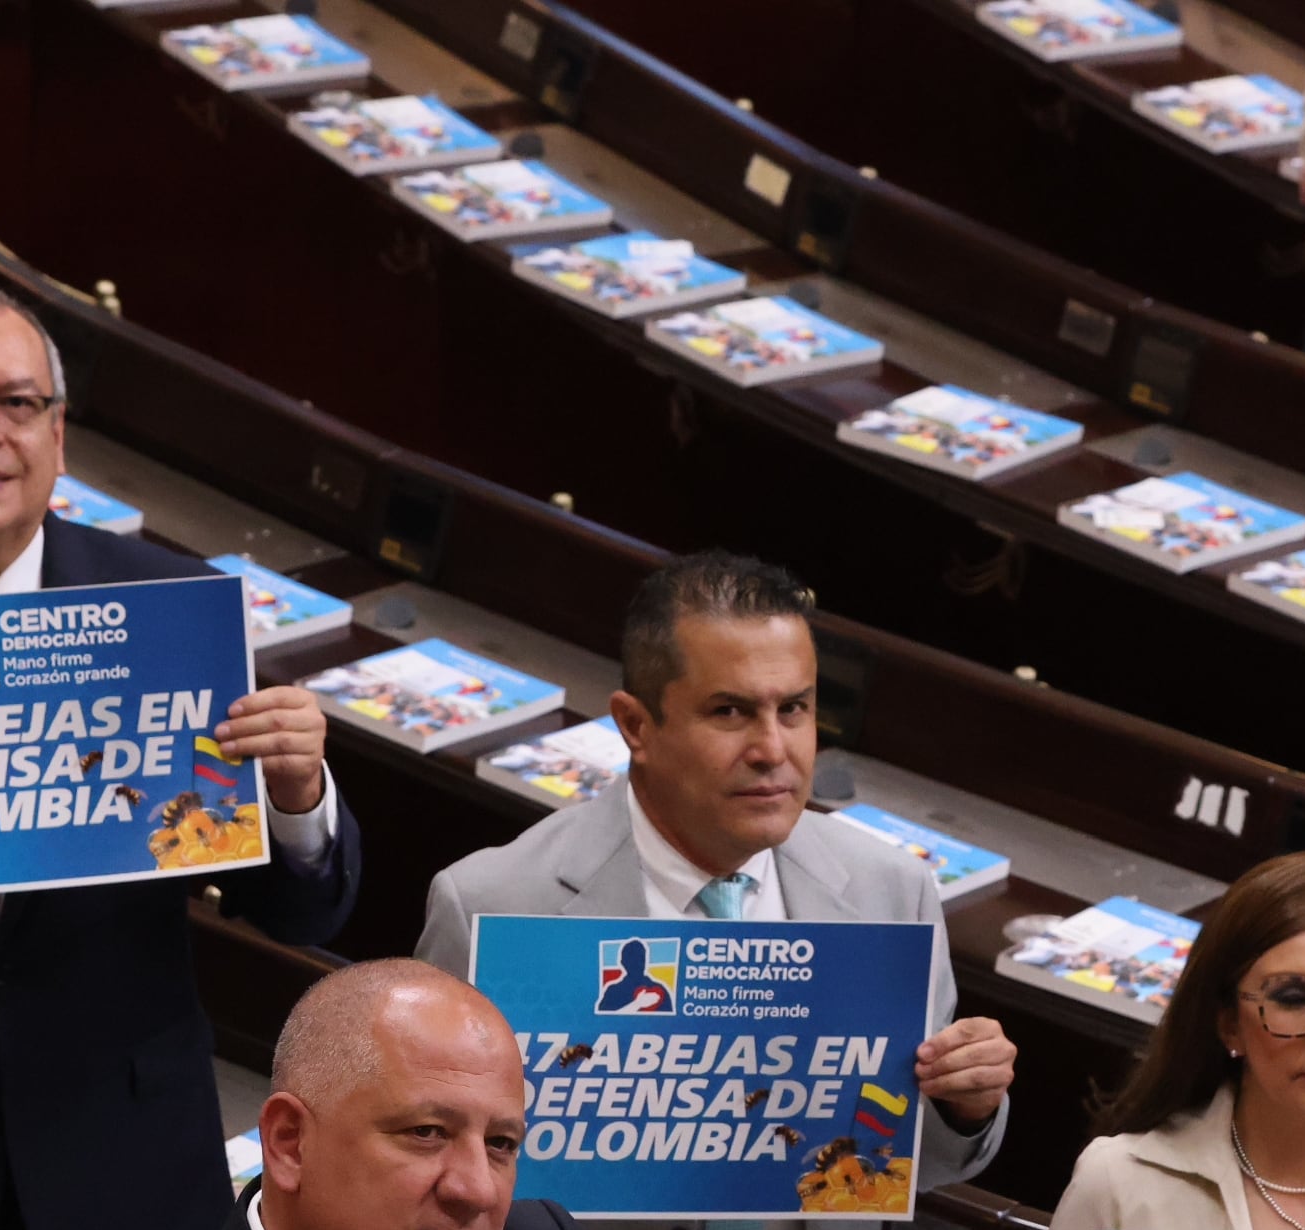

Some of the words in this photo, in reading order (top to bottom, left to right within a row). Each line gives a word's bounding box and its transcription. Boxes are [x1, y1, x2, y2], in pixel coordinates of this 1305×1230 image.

[0, 602, 126, 634] CENTRO
[2, 629, 127, 651] DEMOCRÁTICO
[4, 655, 46, 670] Mano
[50, 652, 92, 667] firme
[4, 670, 70, 687] Corazón
[74, 665, 130, 684] grande
[136, 689, 212, 733] EN
[100, 736, 175, 779] DE
[686, 938, 814, 964] CENTRO
[685, 964, 812, 981] DEMOCRÁTICO
[684, 986, 728, 1000] Mano
[732, 986, 774, 1000] firme
[683, 1002, 749, 1018] Corazón
[753, 1004, 809, 1020] grande
[577, 1033, 798, 1075] ABEJAS
[807, 1036, 888, 1076] EN
[524, 1078, 747, 1118] EFENSA
[763, 1080, 843, 1119] DE
[516, 1121, 789, 1161] OLOMBIA
